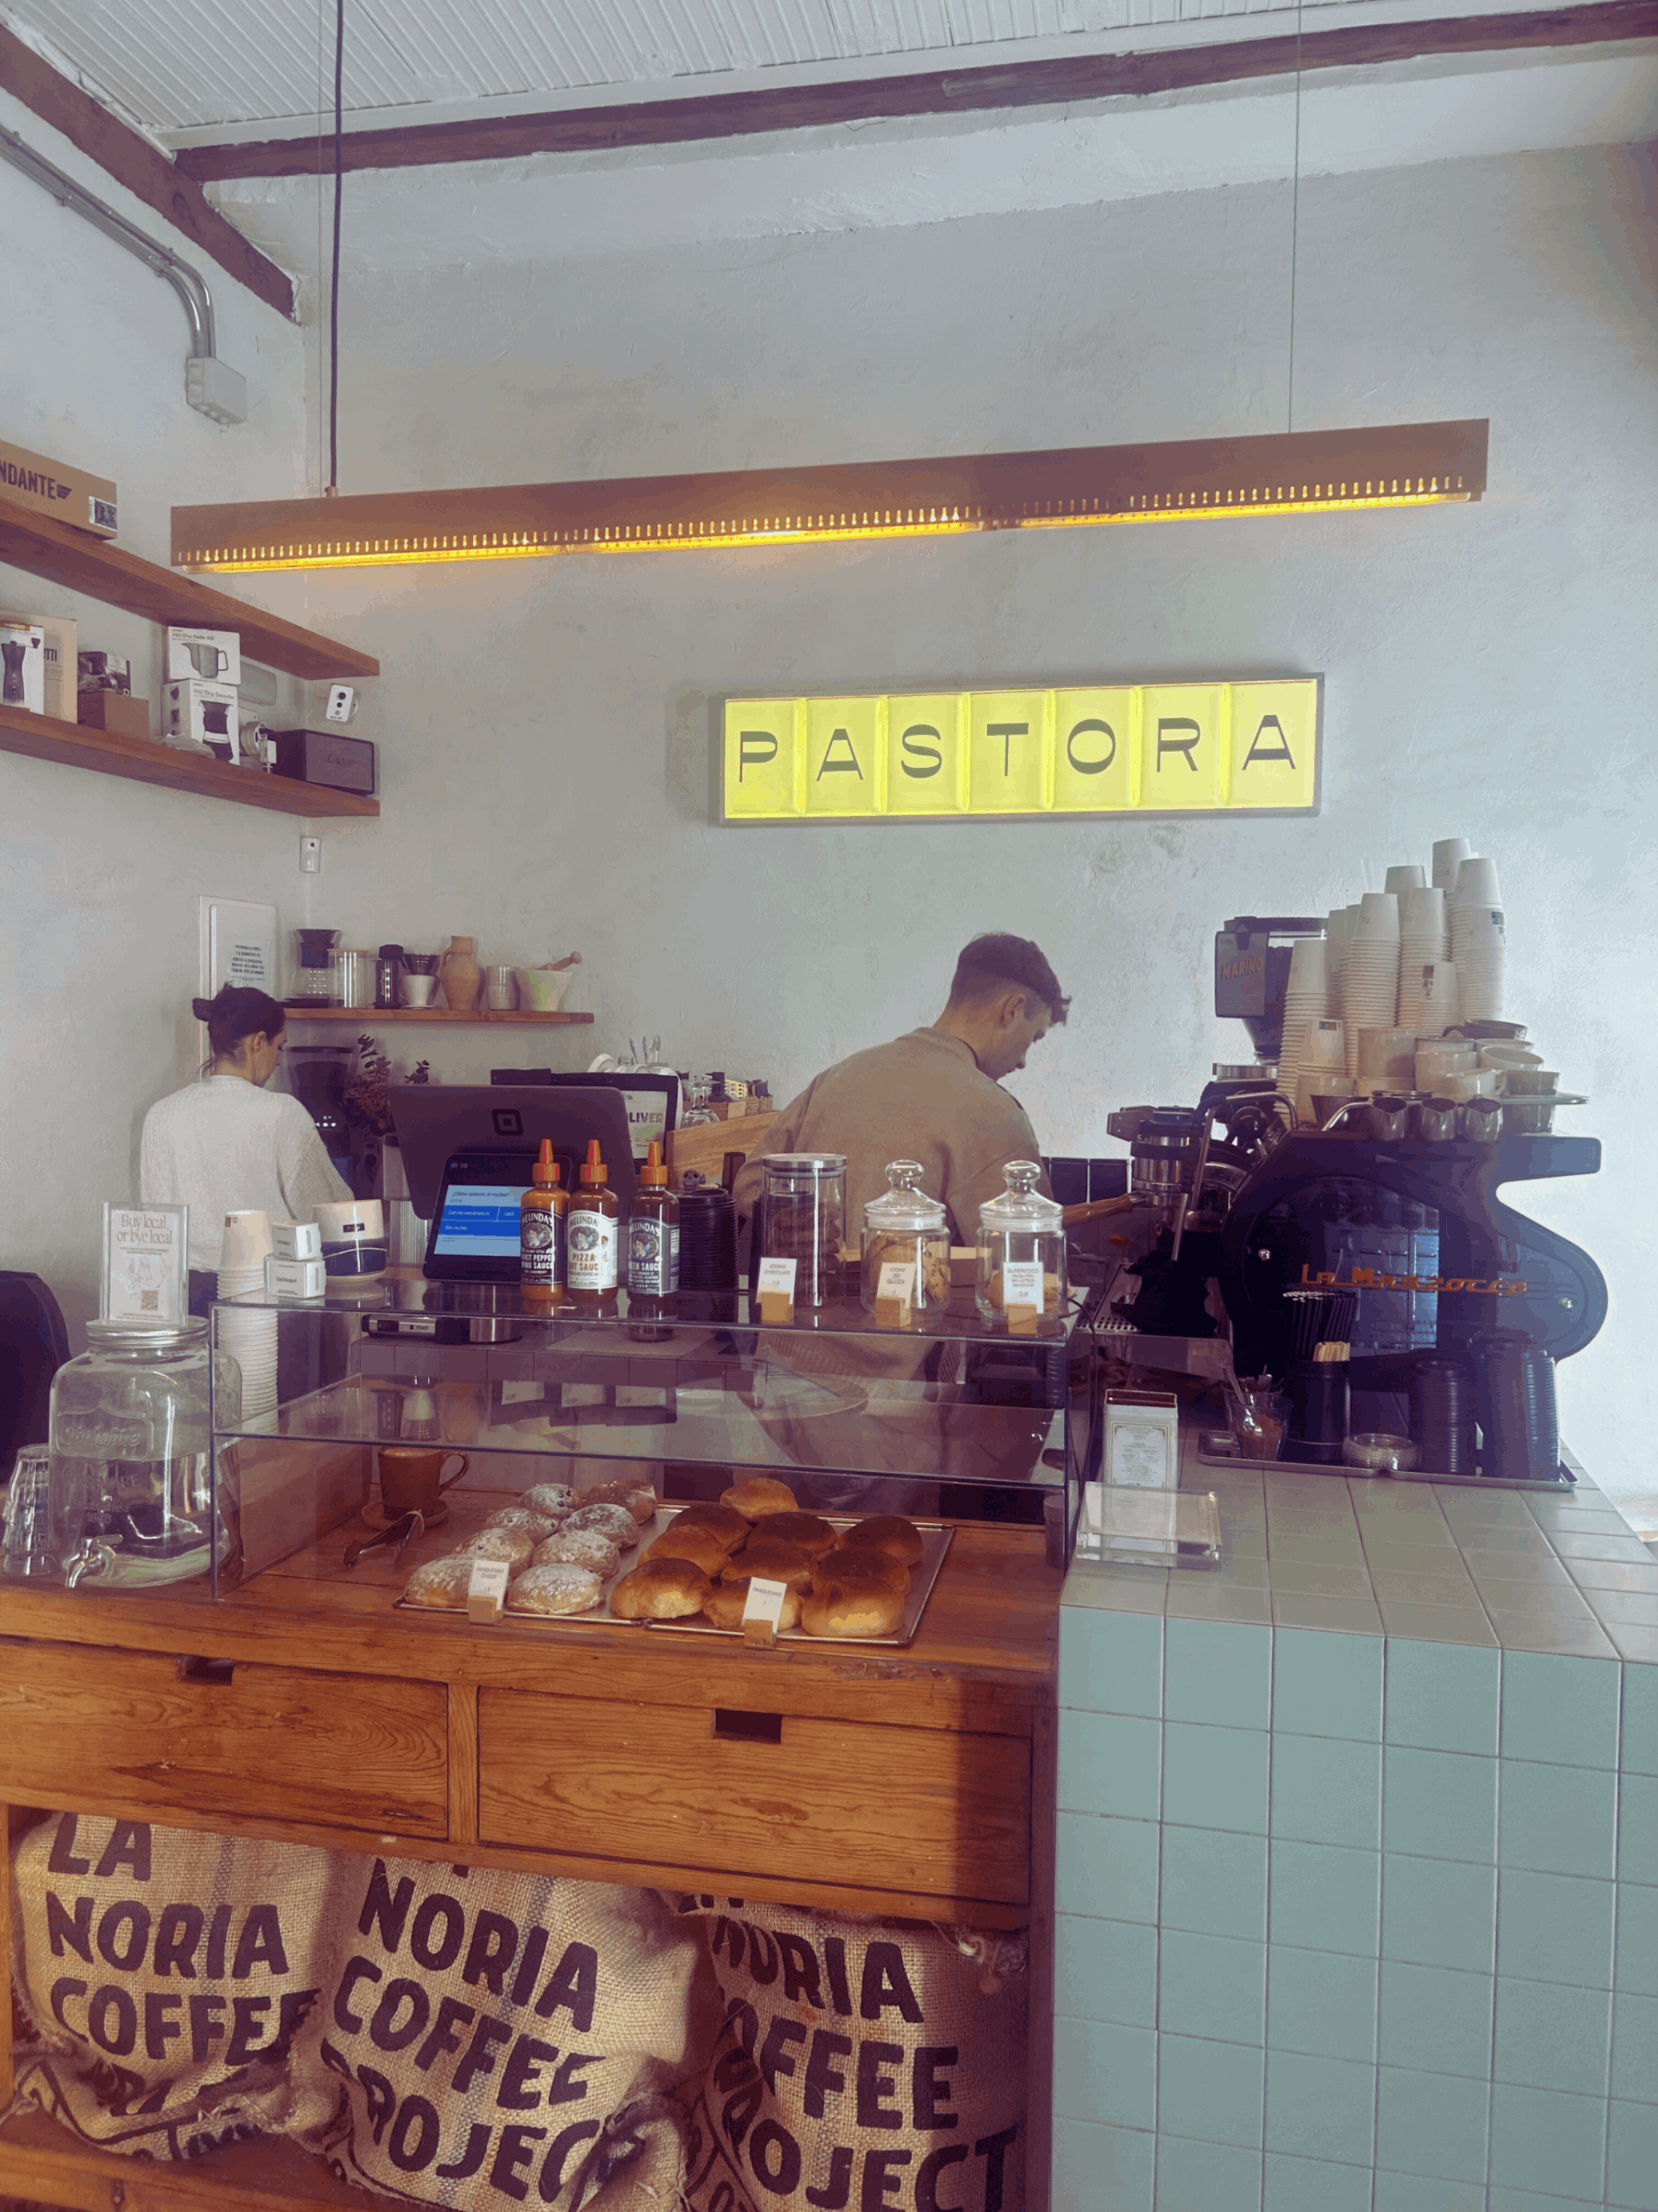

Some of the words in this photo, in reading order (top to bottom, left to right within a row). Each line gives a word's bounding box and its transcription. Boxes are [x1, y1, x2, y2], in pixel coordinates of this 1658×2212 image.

[739, 714, 1296, 783] PASTORA
[1220, 952, 1264, 980] NARIÑO
[116, 1231, 129, 1242] or
[130, 1229, 148, 1246] bye
[150, 1229, 172, 1245] local
[121, 1214, 143, 1232] Buy
[143, 1214, 169, 1231] local,
[573, 1253, 596, 1261] PIZZA
[1302, 1264, 1335, 1287] La
[1350, 1267, 1527, 1295] Marzocco
[48, 1812, 152, 1881] LA
[46, 1891, 289, 1980] NORIA
[358, 1858, 598, 2033] NORIA
[334, 1955, 605, 2111] COFFEE
